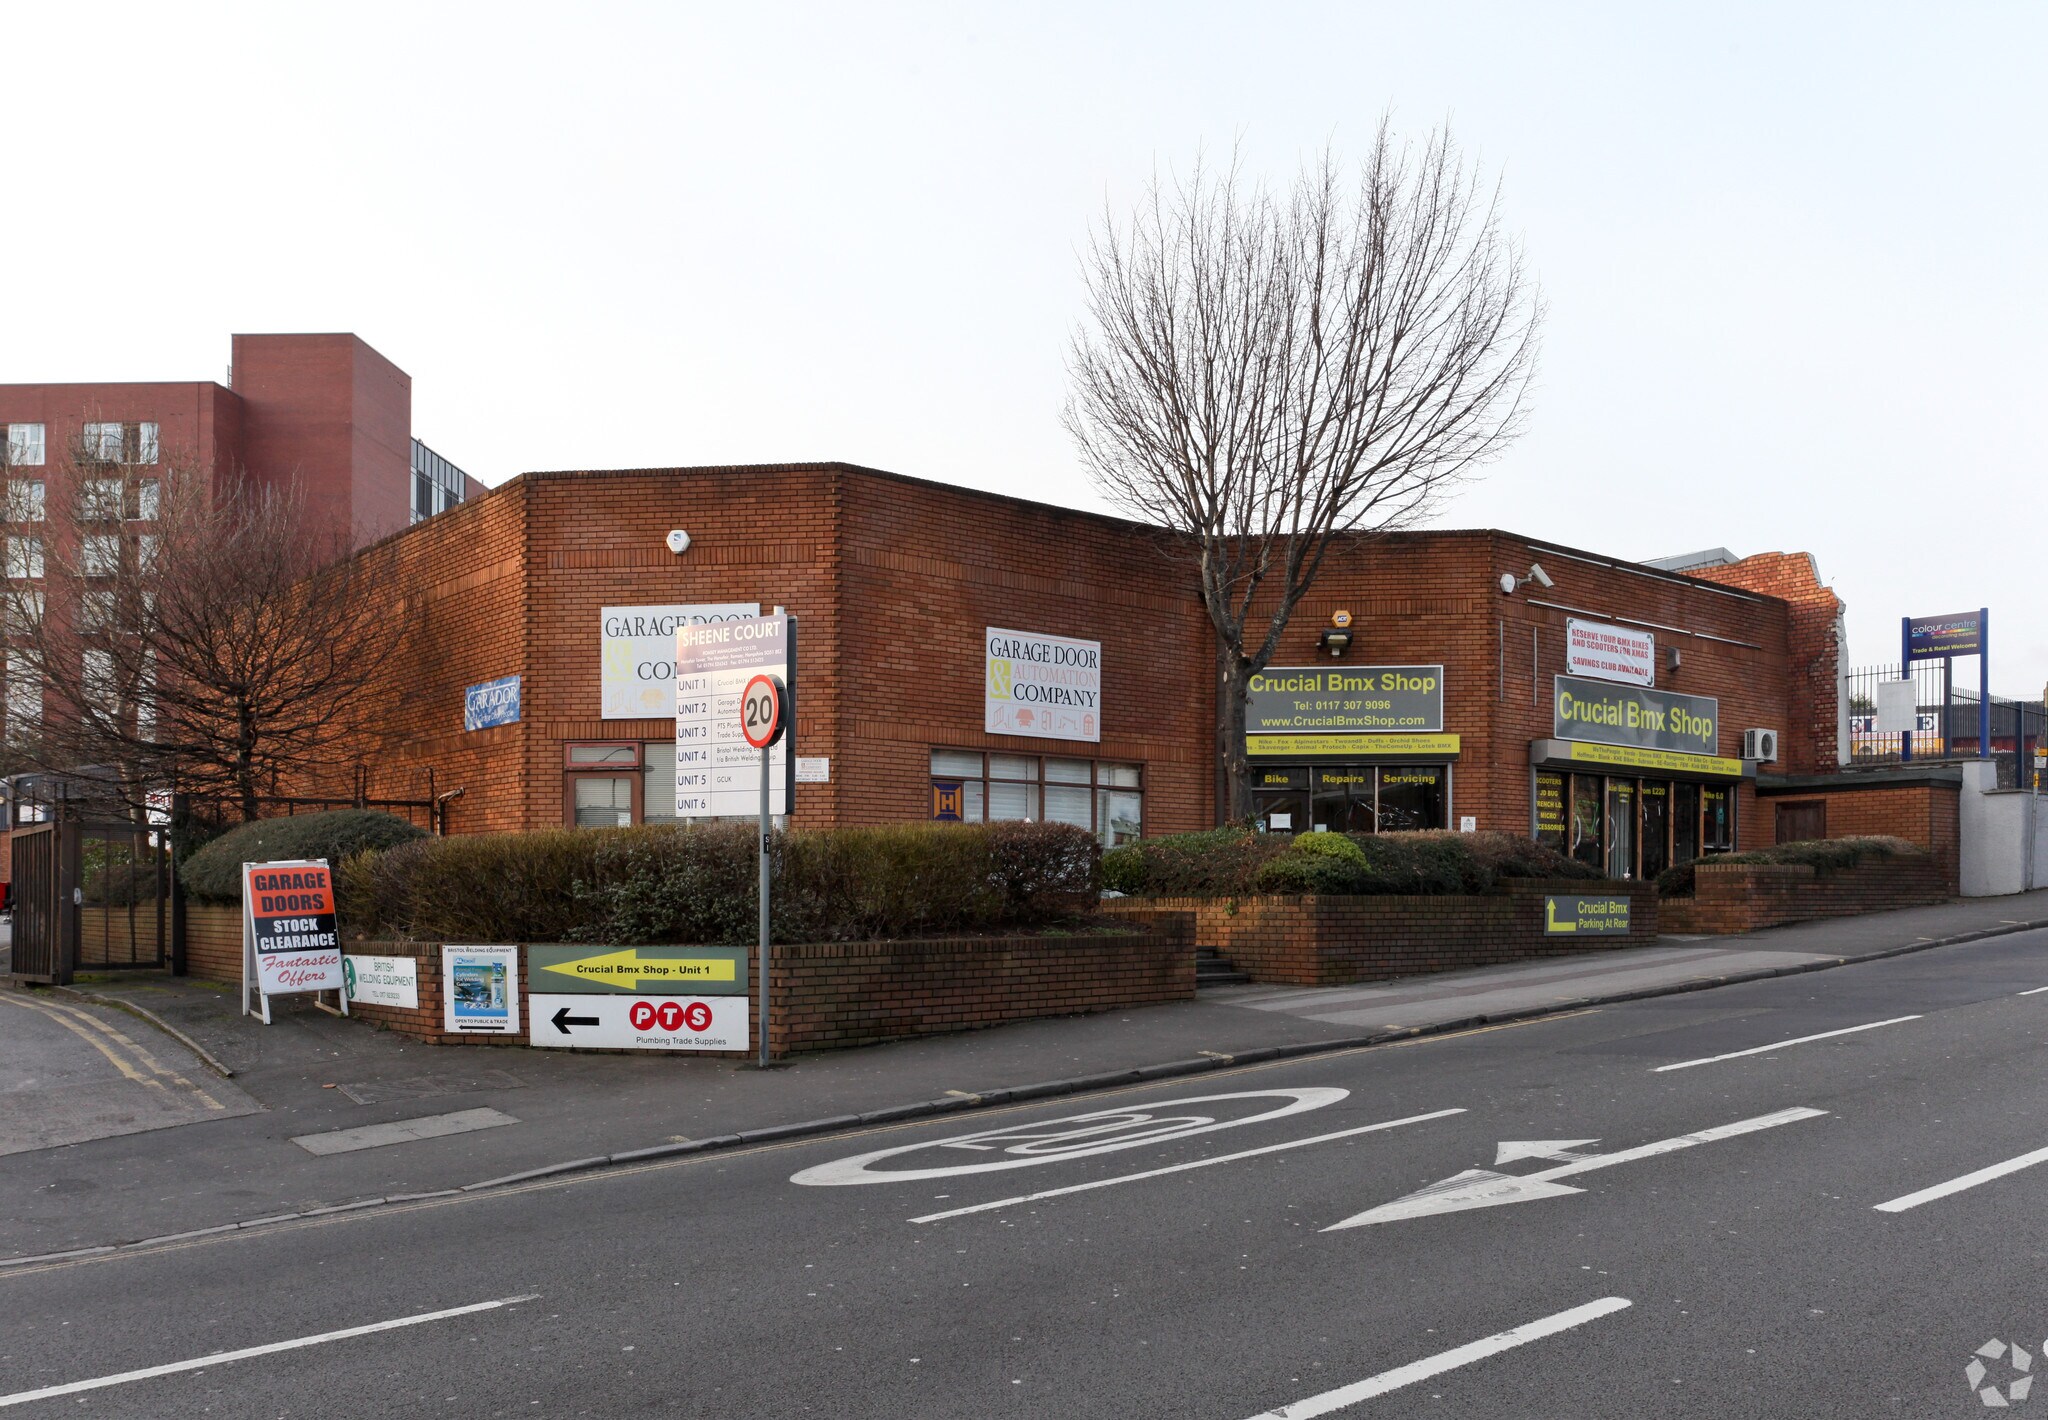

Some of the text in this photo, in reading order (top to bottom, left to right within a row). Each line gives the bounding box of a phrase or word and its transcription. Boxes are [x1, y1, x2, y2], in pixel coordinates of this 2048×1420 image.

[605, 615, 685, 638] GARAGE
[682, 621, 780, 647] SHEENE COURT
[1912, 619, 1976, 634] colour centre
[1572, 629, 1648, 650] RESERVE YOUR BMX BIKES
[990, 637, 1098, 669] GARAGE DOOR
[1572, 638, 1648, 659] AND SCOOTERS FOR XMAS
[1572, 656, 1648, 676] SAVINGS CLUB AVAILABLE
[678, 680, 699, 691] UNIT
[702, 679, 706, 689] 1
[990, 661, 1097, 697] & AUTOMATION
[1250, 674, 1436, 695] Crucial Bmx Shop
[468, 687, 518, 711] GARADOR
[1014, 684, 1097, 708] COMPANY
[678, 704, 699, 714] UNIT
[702, 703, 706, 713] 2
[746, 695, 772, 727] 20
[1294, 700, 1390, 710] Tel: 0117 307 9096
[1261, 716, 1425, 728] www.CrucialBmxShop.com
[1559, 691, 1712, 743] Crucial Bmx Shop
[678, 728, 698, 738] UNIT
[702, 727, 706, 737] 3
[732, 731, 744, 739] Supp
[678, 752, 698, 762] UNIT
[701, 751, 706, 760] 4
[733, 746, 752, 754] Welding
[678, 776, 698, 786] UNIT
[701, 775, 706, 785] 5
[1264, 774, 1436, 785] Bike Repairs Servicing
[1536, 778, 1562, 786] SCOOTERS
[1618, 785, 1634, 794] Bikes
[1652, 788, 1665, 796] £220
[1716, 792, 1724, 800] 6.0
[678, 798, 706, 810] UNIT 6
[1536, 800, 1554, 808] RENCH
[1540, 812, 1556, 820] MICRO
[255, 872, 326, 891] GARAGE
[261, 894, 325, 912] DOORS
[1578, 901, 1628, 914] Crucial Bmx
[273, 918, 318, 934] STOCK
[1578, 918, 1628, 930] Parking At Rear
[260, 933, 336, 950] CLEARANCE
[262, 954, 339, 972] Fantastic
[374, 962, 394, 972] BRITISH
[576, 965, 710, 976] Crucial Bmx Shop Unit 1
[278, 970, 326, 987] Offers
[360, 974, 414, 986] WELDING EQUIPMENT
[636, 1008, 706, 1026] PTS
[636, 1036, 726, 1046] Plumbing Trade Supplies
[940, 1113, 1216, 1154] 20
